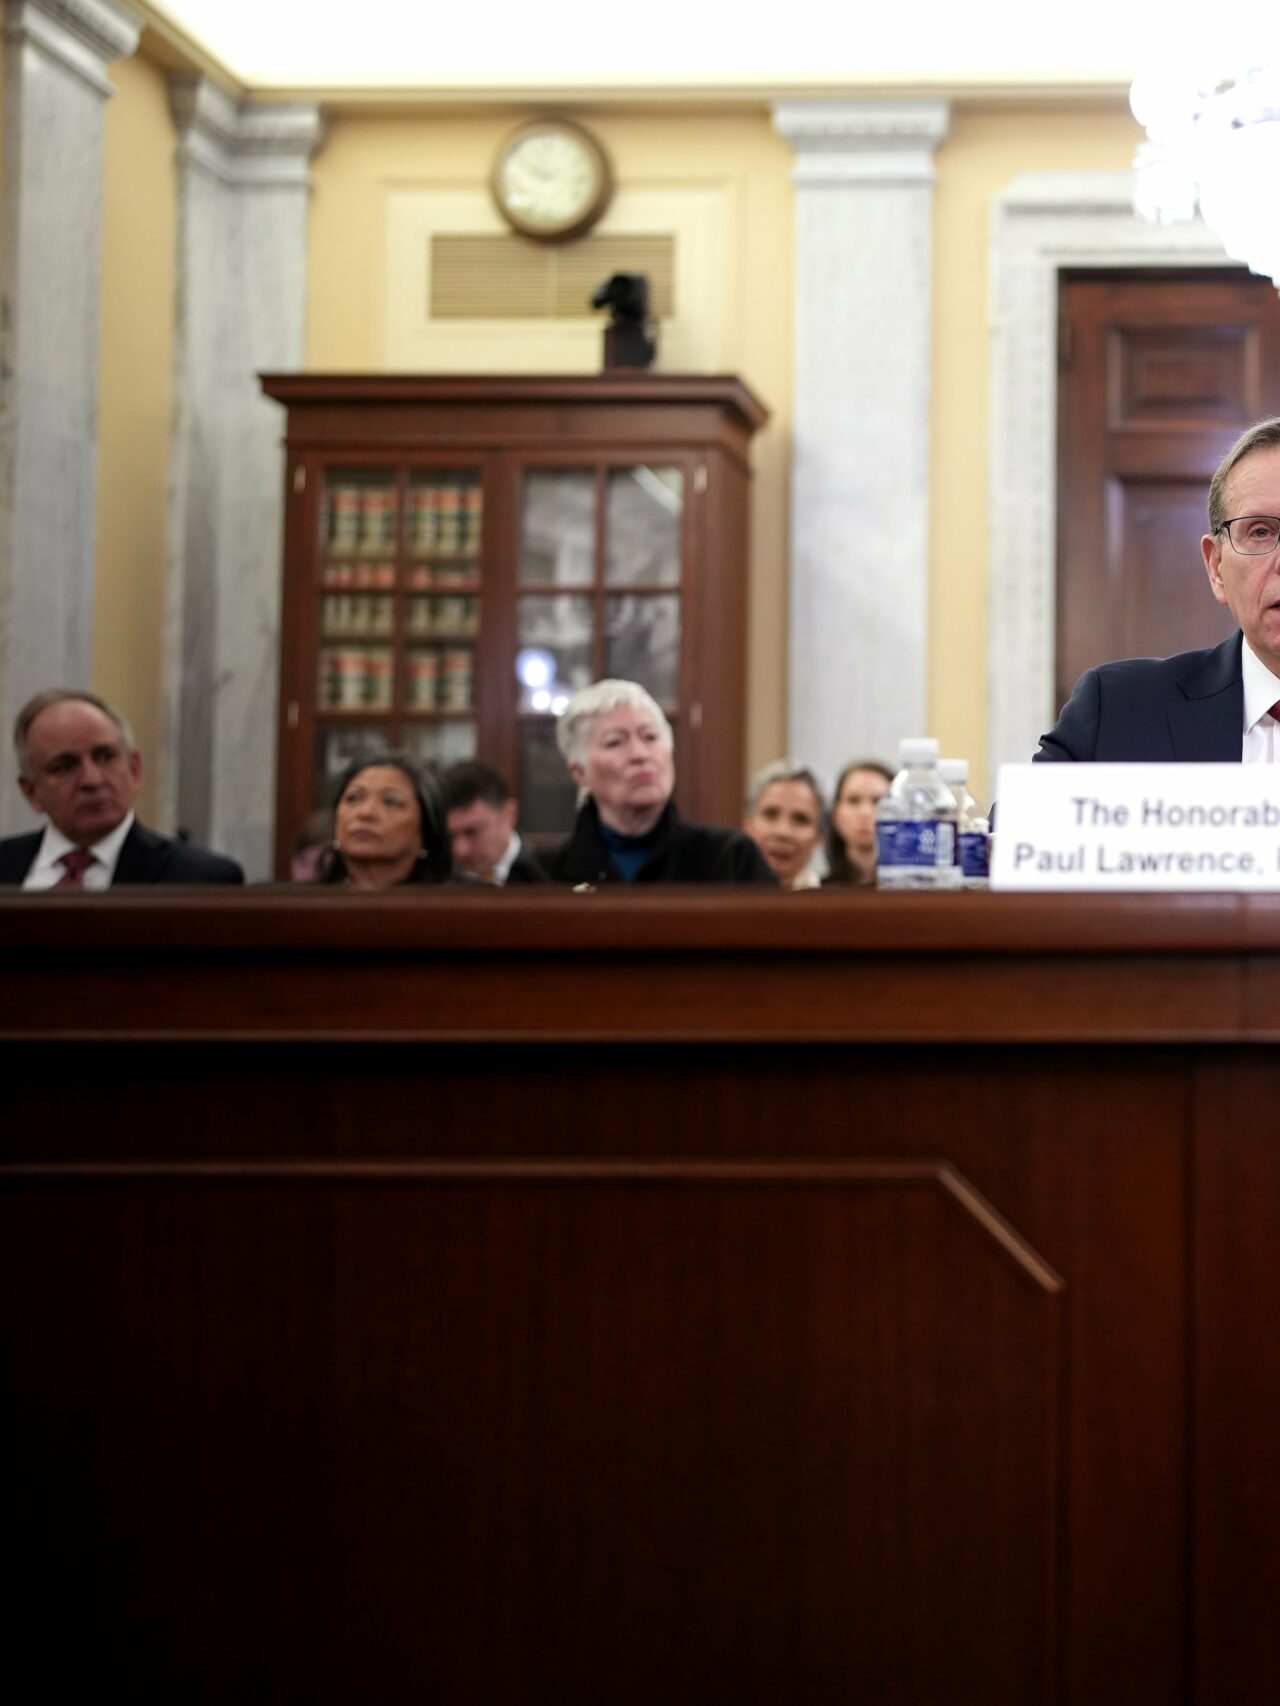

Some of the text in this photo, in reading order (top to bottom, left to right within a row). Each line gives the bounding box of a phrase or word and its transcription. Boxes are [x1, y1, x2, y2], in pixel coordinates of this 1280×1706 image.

[1071, 796, 1131, 826] The
[1012, 842, 1085, 873] Paul
[1097, 845, 1266, 877] Lawrence,
